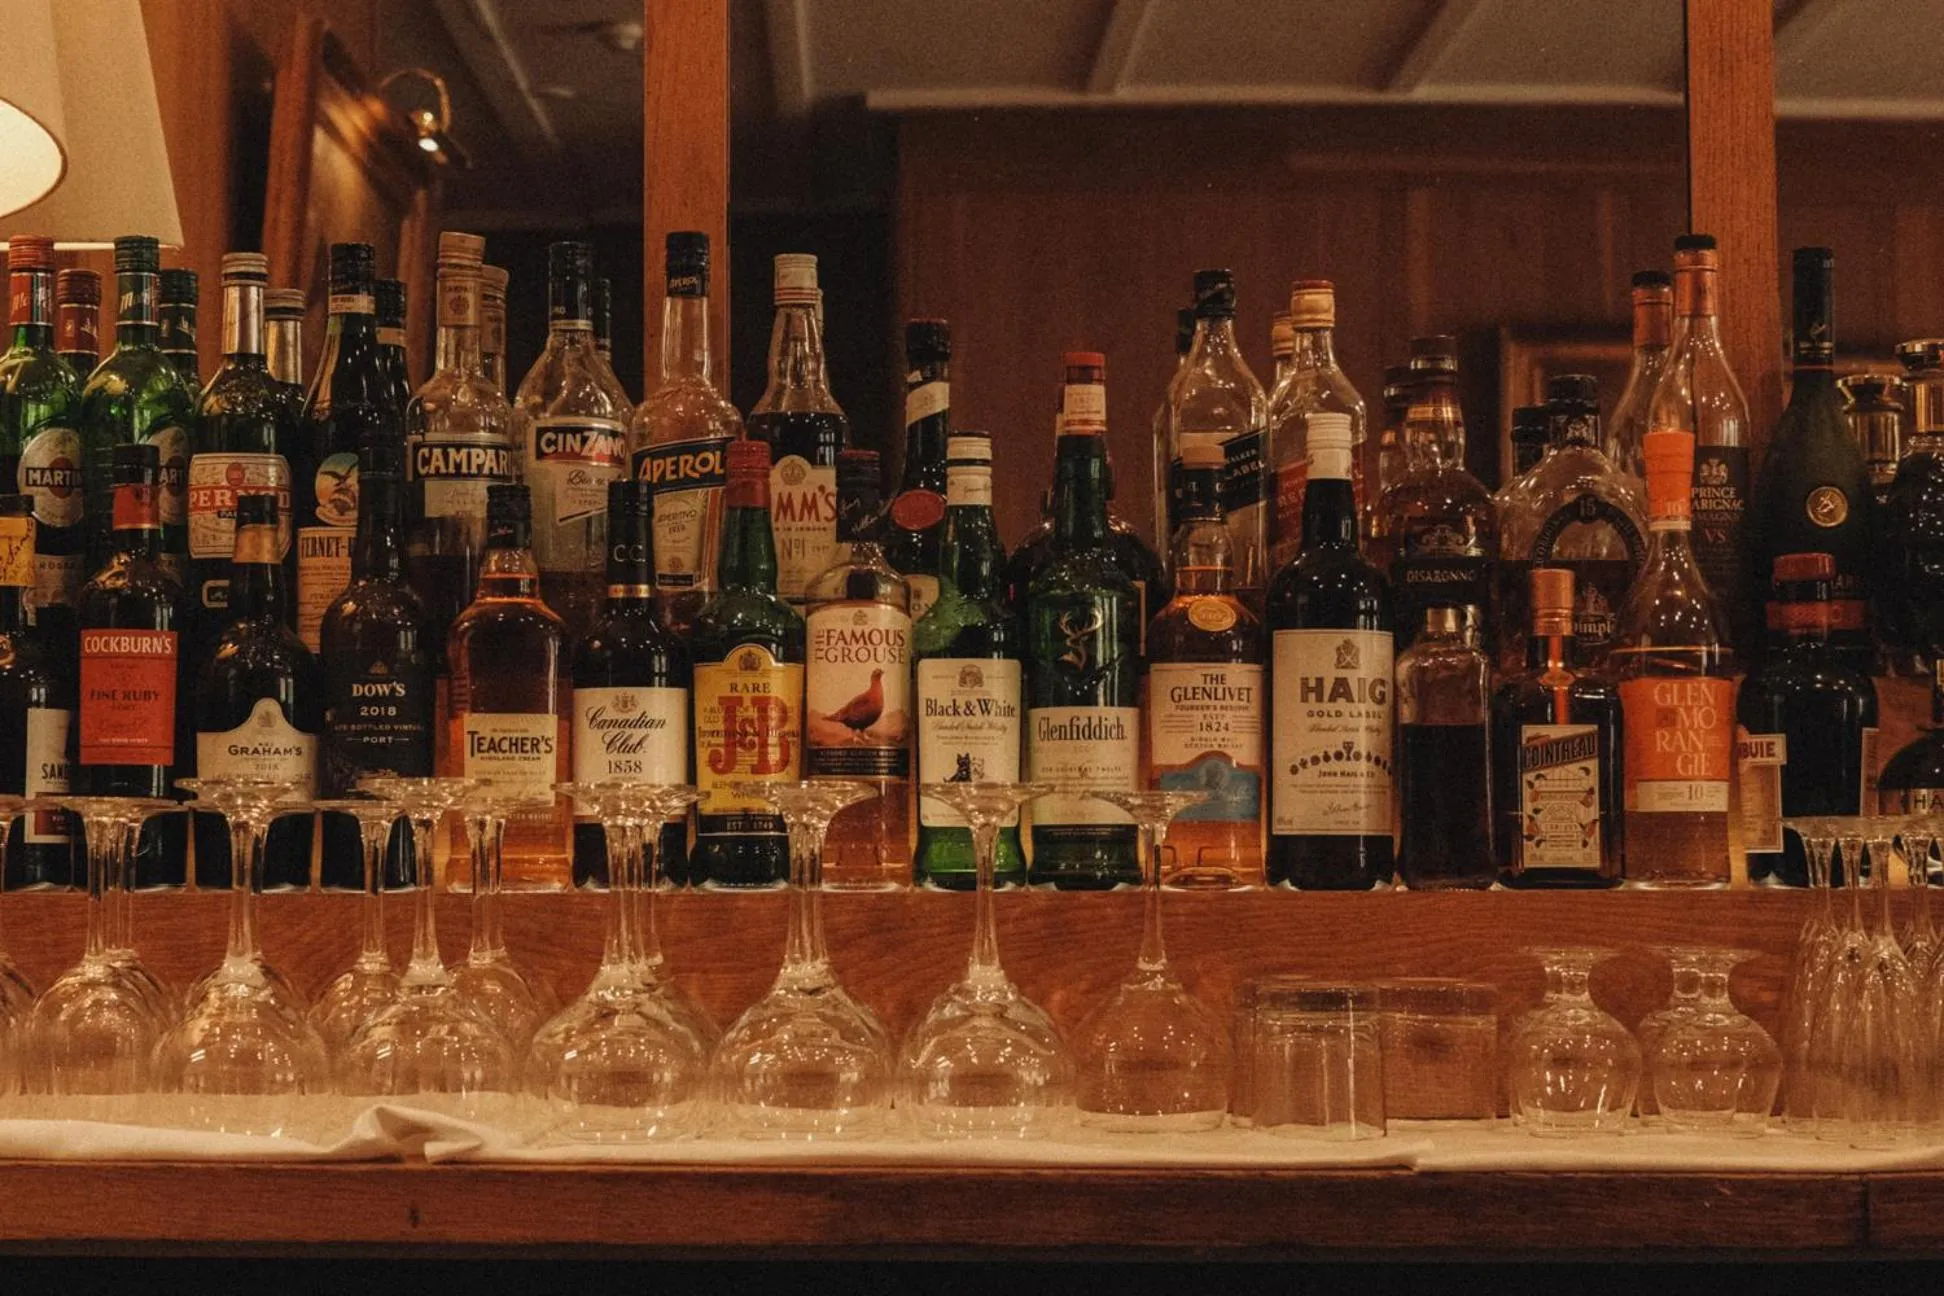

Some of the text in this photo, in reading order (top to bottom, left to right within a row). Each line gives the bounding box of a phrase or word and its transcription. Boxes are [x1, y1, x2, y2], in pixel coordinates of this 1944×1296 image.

[540, 431, 625, 457] CINZANO
[639, 451, 725, 484] APEROL
[83, 635, 173, 655] COCKBURN'S
[825, 627, 906, 647] FAMOUS
[824, 647, 906, 665] GROUSE
[351, 681, 406, 697] DOW'S
[729, 682, 771, 694] RARE
[1200, 673, 1227, 685] THE
[1170, 686, 1253, 704] GLENLIVET
[1300, 676, 1387, 706] HAIG
[1654, 682, 1717, 706] GLEN
[360, 705, 398, 717] 2018
[925, 697, 1016, 718] Black & White
[1306, 709, 1344, 719] GOLD
[584, 705, 667, 731] Canadian
[1038, 715, 1126, 741] Glenfiddich
[1199, 721, 1230, 733] 1824
[1677, 706, 1718, 730] MO
[363, 735, 394, 744] PORT
[466, 729, 554, 758] TEACHER'S
[1655, 729, 1705, 753] RAN
[227, 744, 303, 757] GRAHAM'S
[608, 759, 643, 775] 1858
[1676, 752, 1712, 777] GIE
